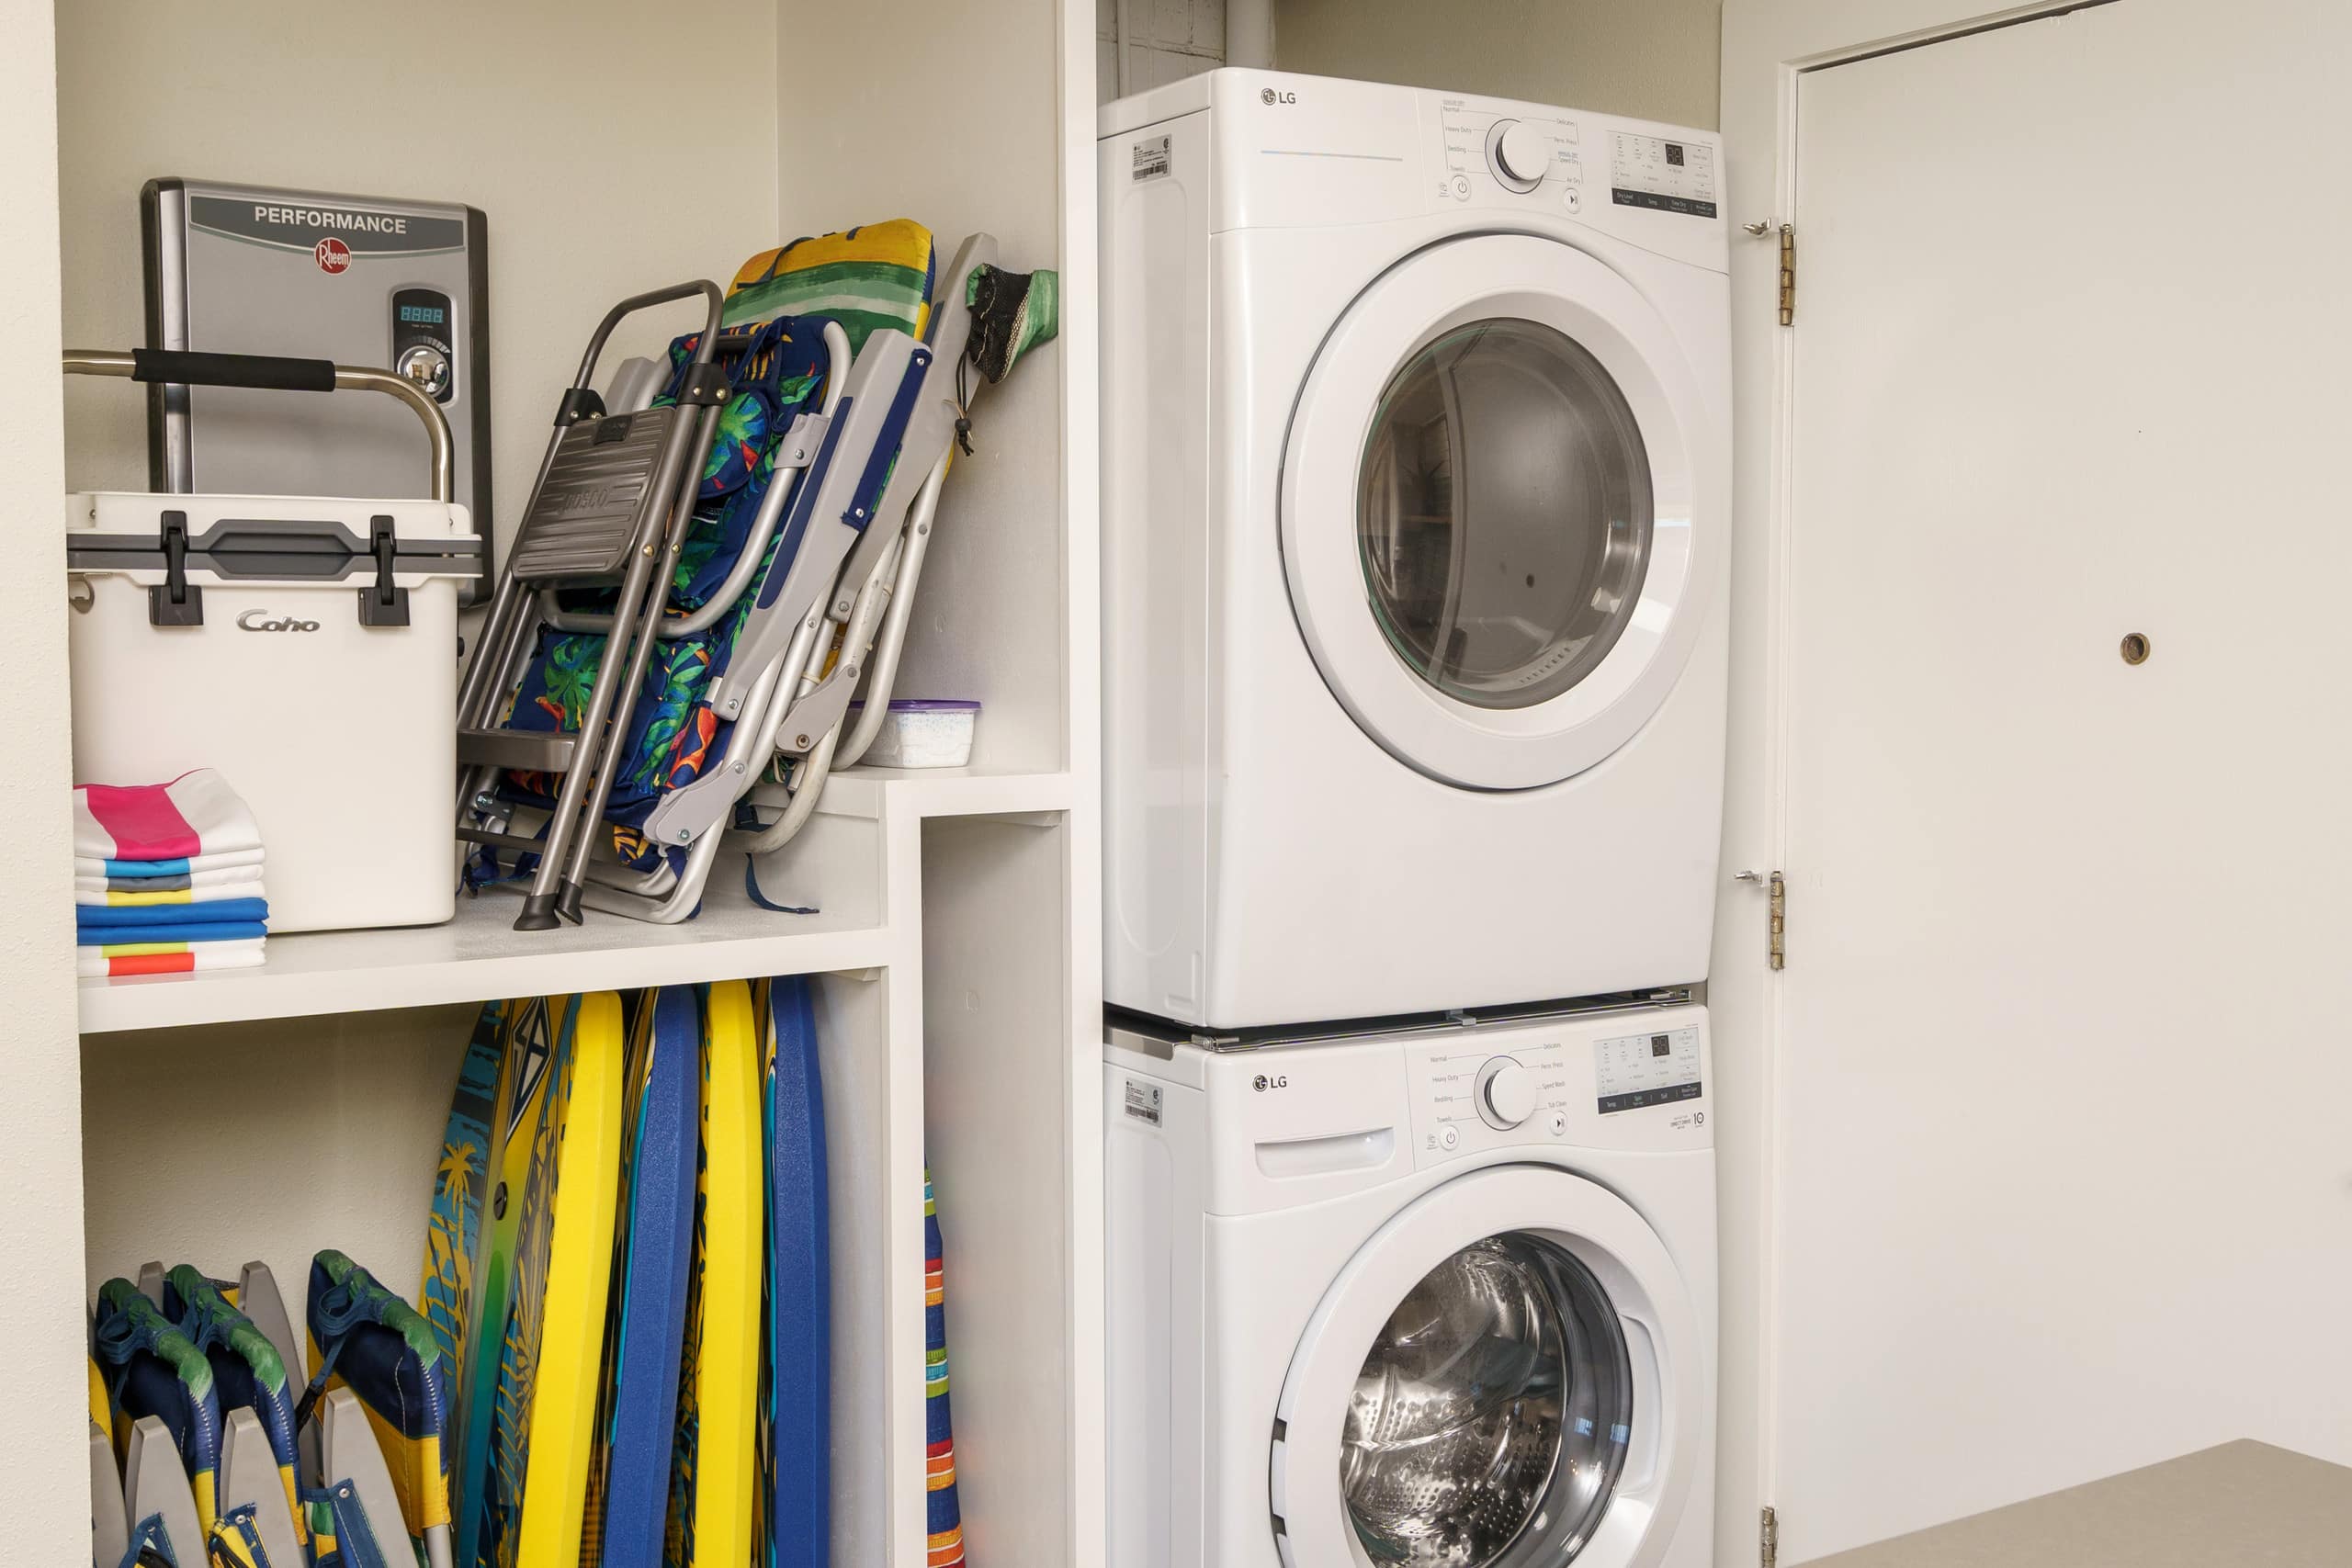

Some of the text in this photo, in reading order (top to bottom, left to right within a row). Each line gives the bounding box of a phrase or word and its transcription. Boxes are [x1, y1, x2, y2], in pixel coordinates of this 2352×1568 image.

[1279, 92, 1295, 104] LG
[254, 206, 407, 234] PERFORMANCE
[318, 240, 349, 269] Rheem
[236, 608, 321, 632] Coho
[1271, 1076, 1286, 1088] LG
[1693, 1111, 1704, 1125] 10
